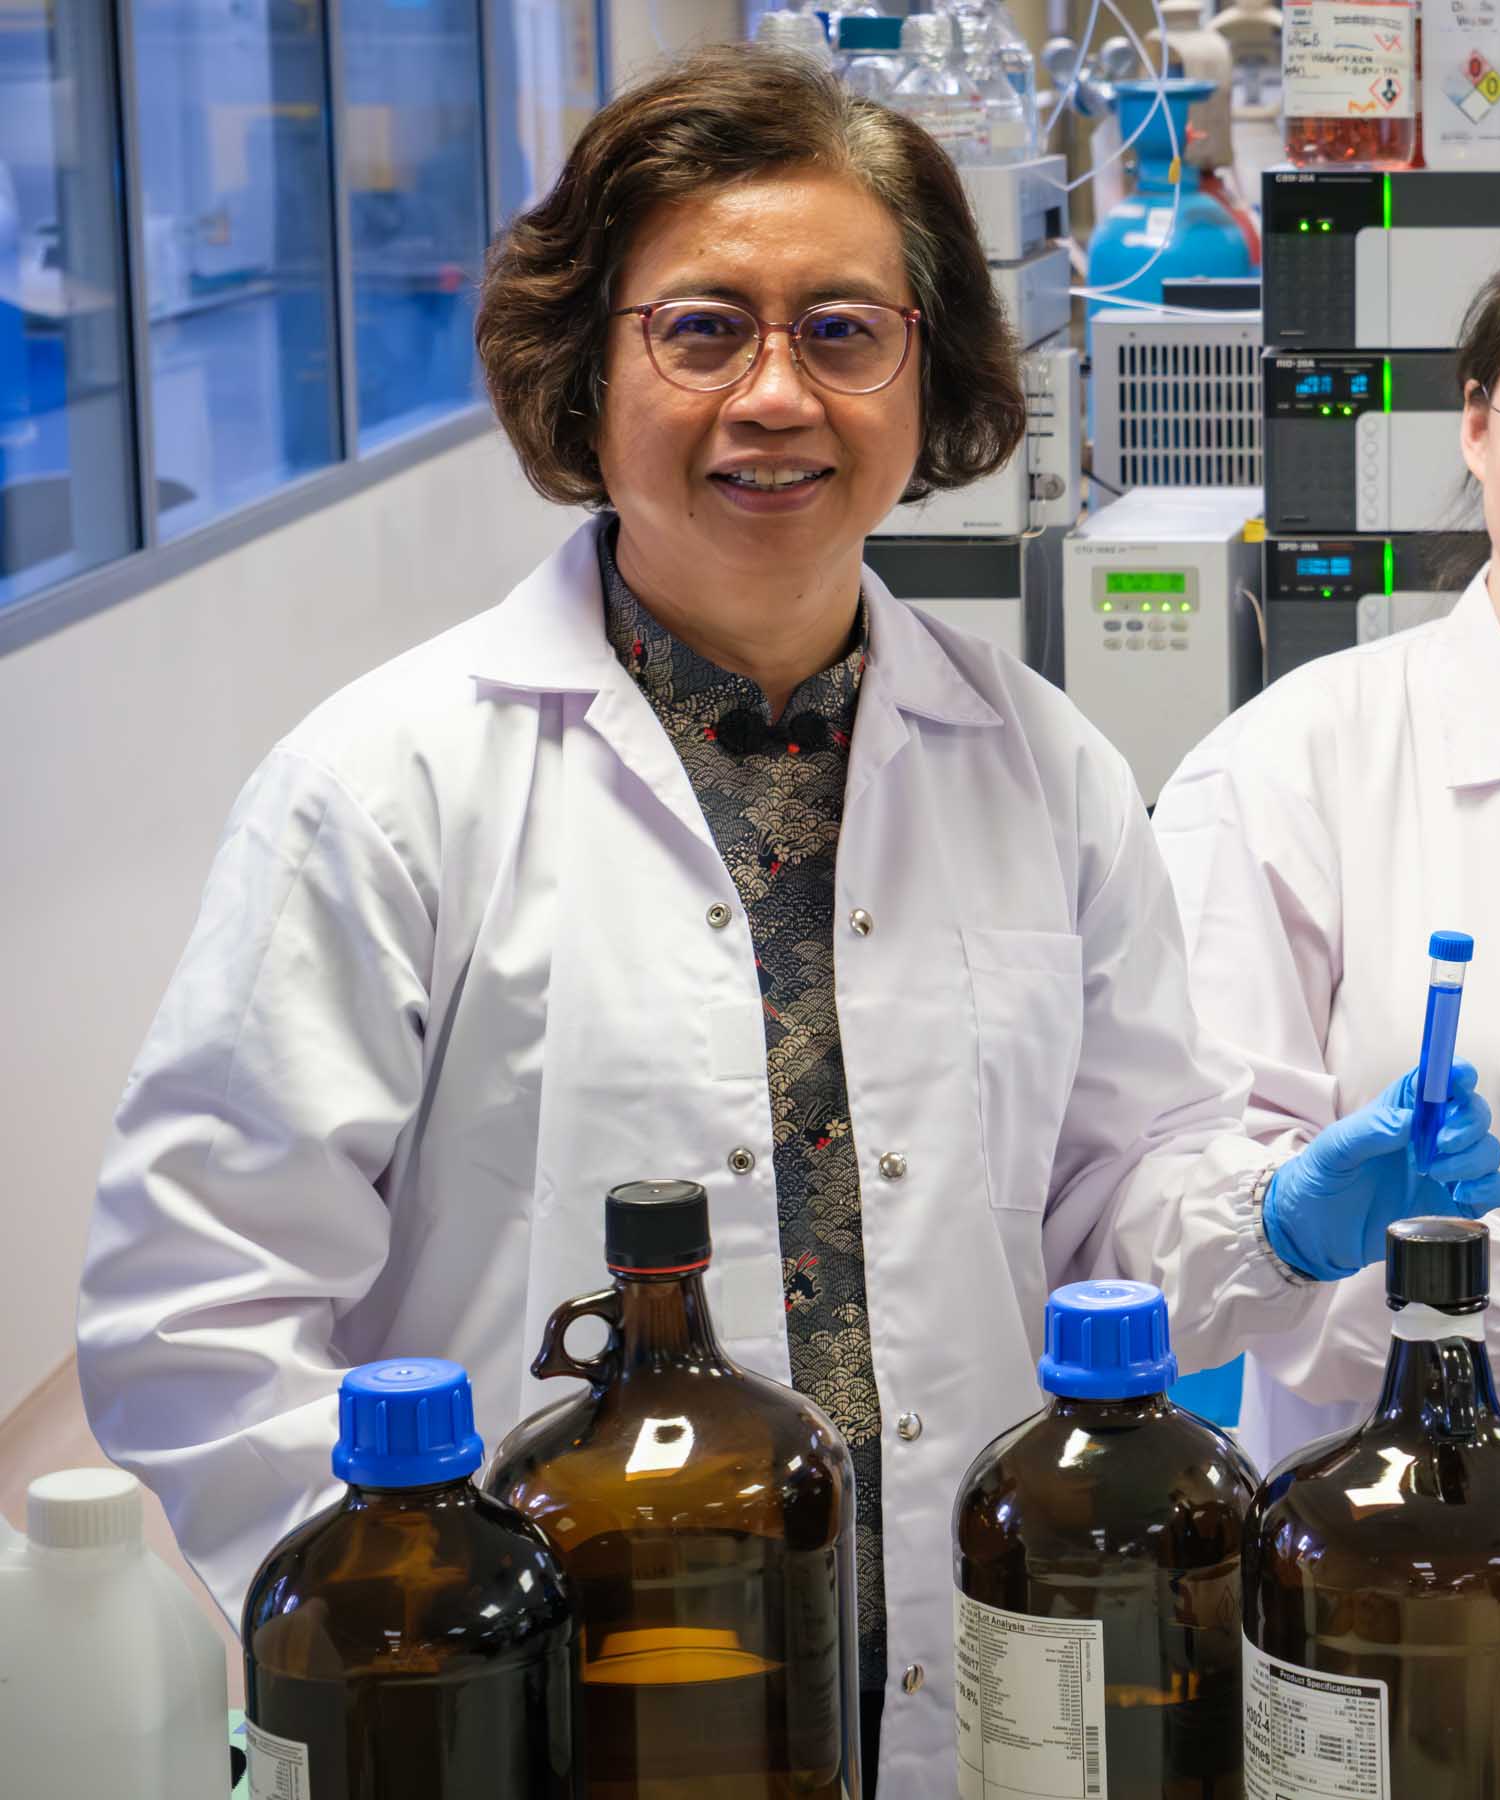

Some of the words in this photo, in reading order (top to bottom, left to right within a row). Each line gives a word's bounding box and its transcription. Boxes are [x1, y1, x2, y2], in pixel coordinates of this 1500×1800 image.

[1486, 77, 1499, 96] 0
[991, 1616, 1025, 1632] Analysis
[1279, 1670, 1305, 1685] Product
[1306, 1678, 1362, 1696] Specifications
